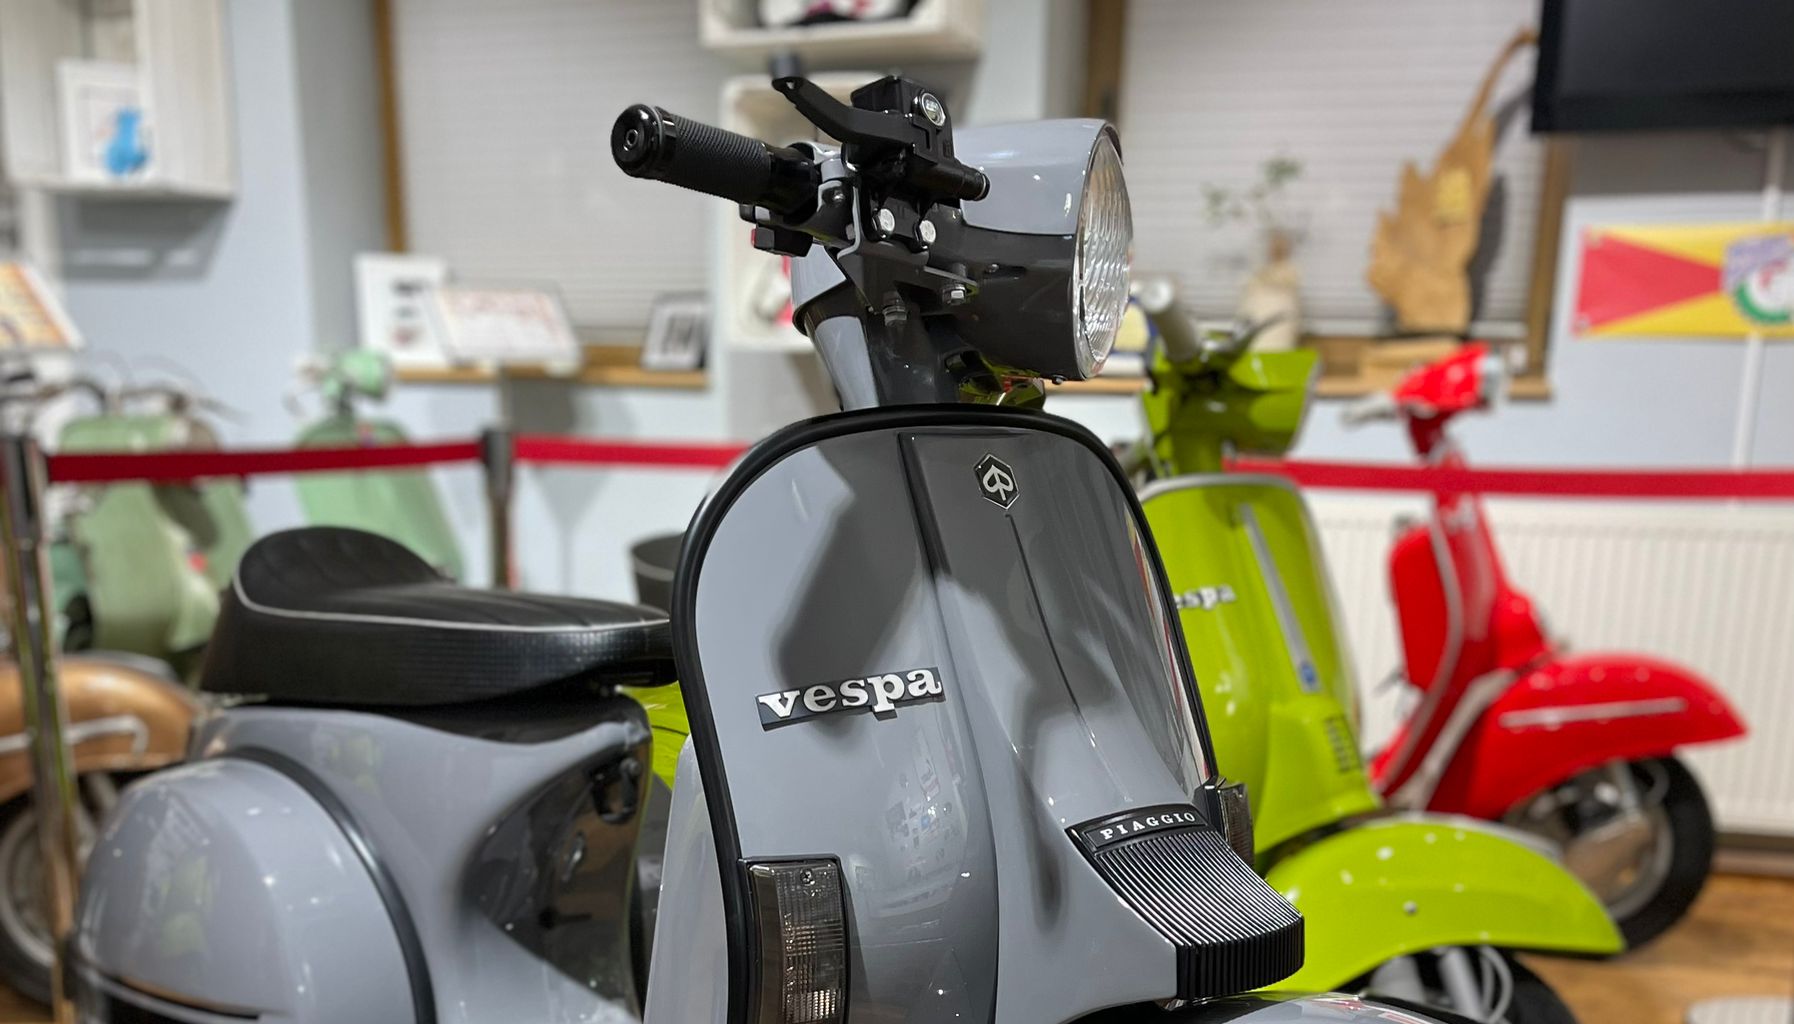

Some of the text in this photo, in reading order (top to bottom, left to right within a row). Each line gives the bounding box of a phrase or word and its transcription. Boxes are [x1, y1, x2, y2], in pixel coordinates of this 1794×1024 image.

[1173, 585, 1236, 611] espa
[758, 668, 943, 719] vespa
[1100, 812, 1196, 840] PIAGGIO
